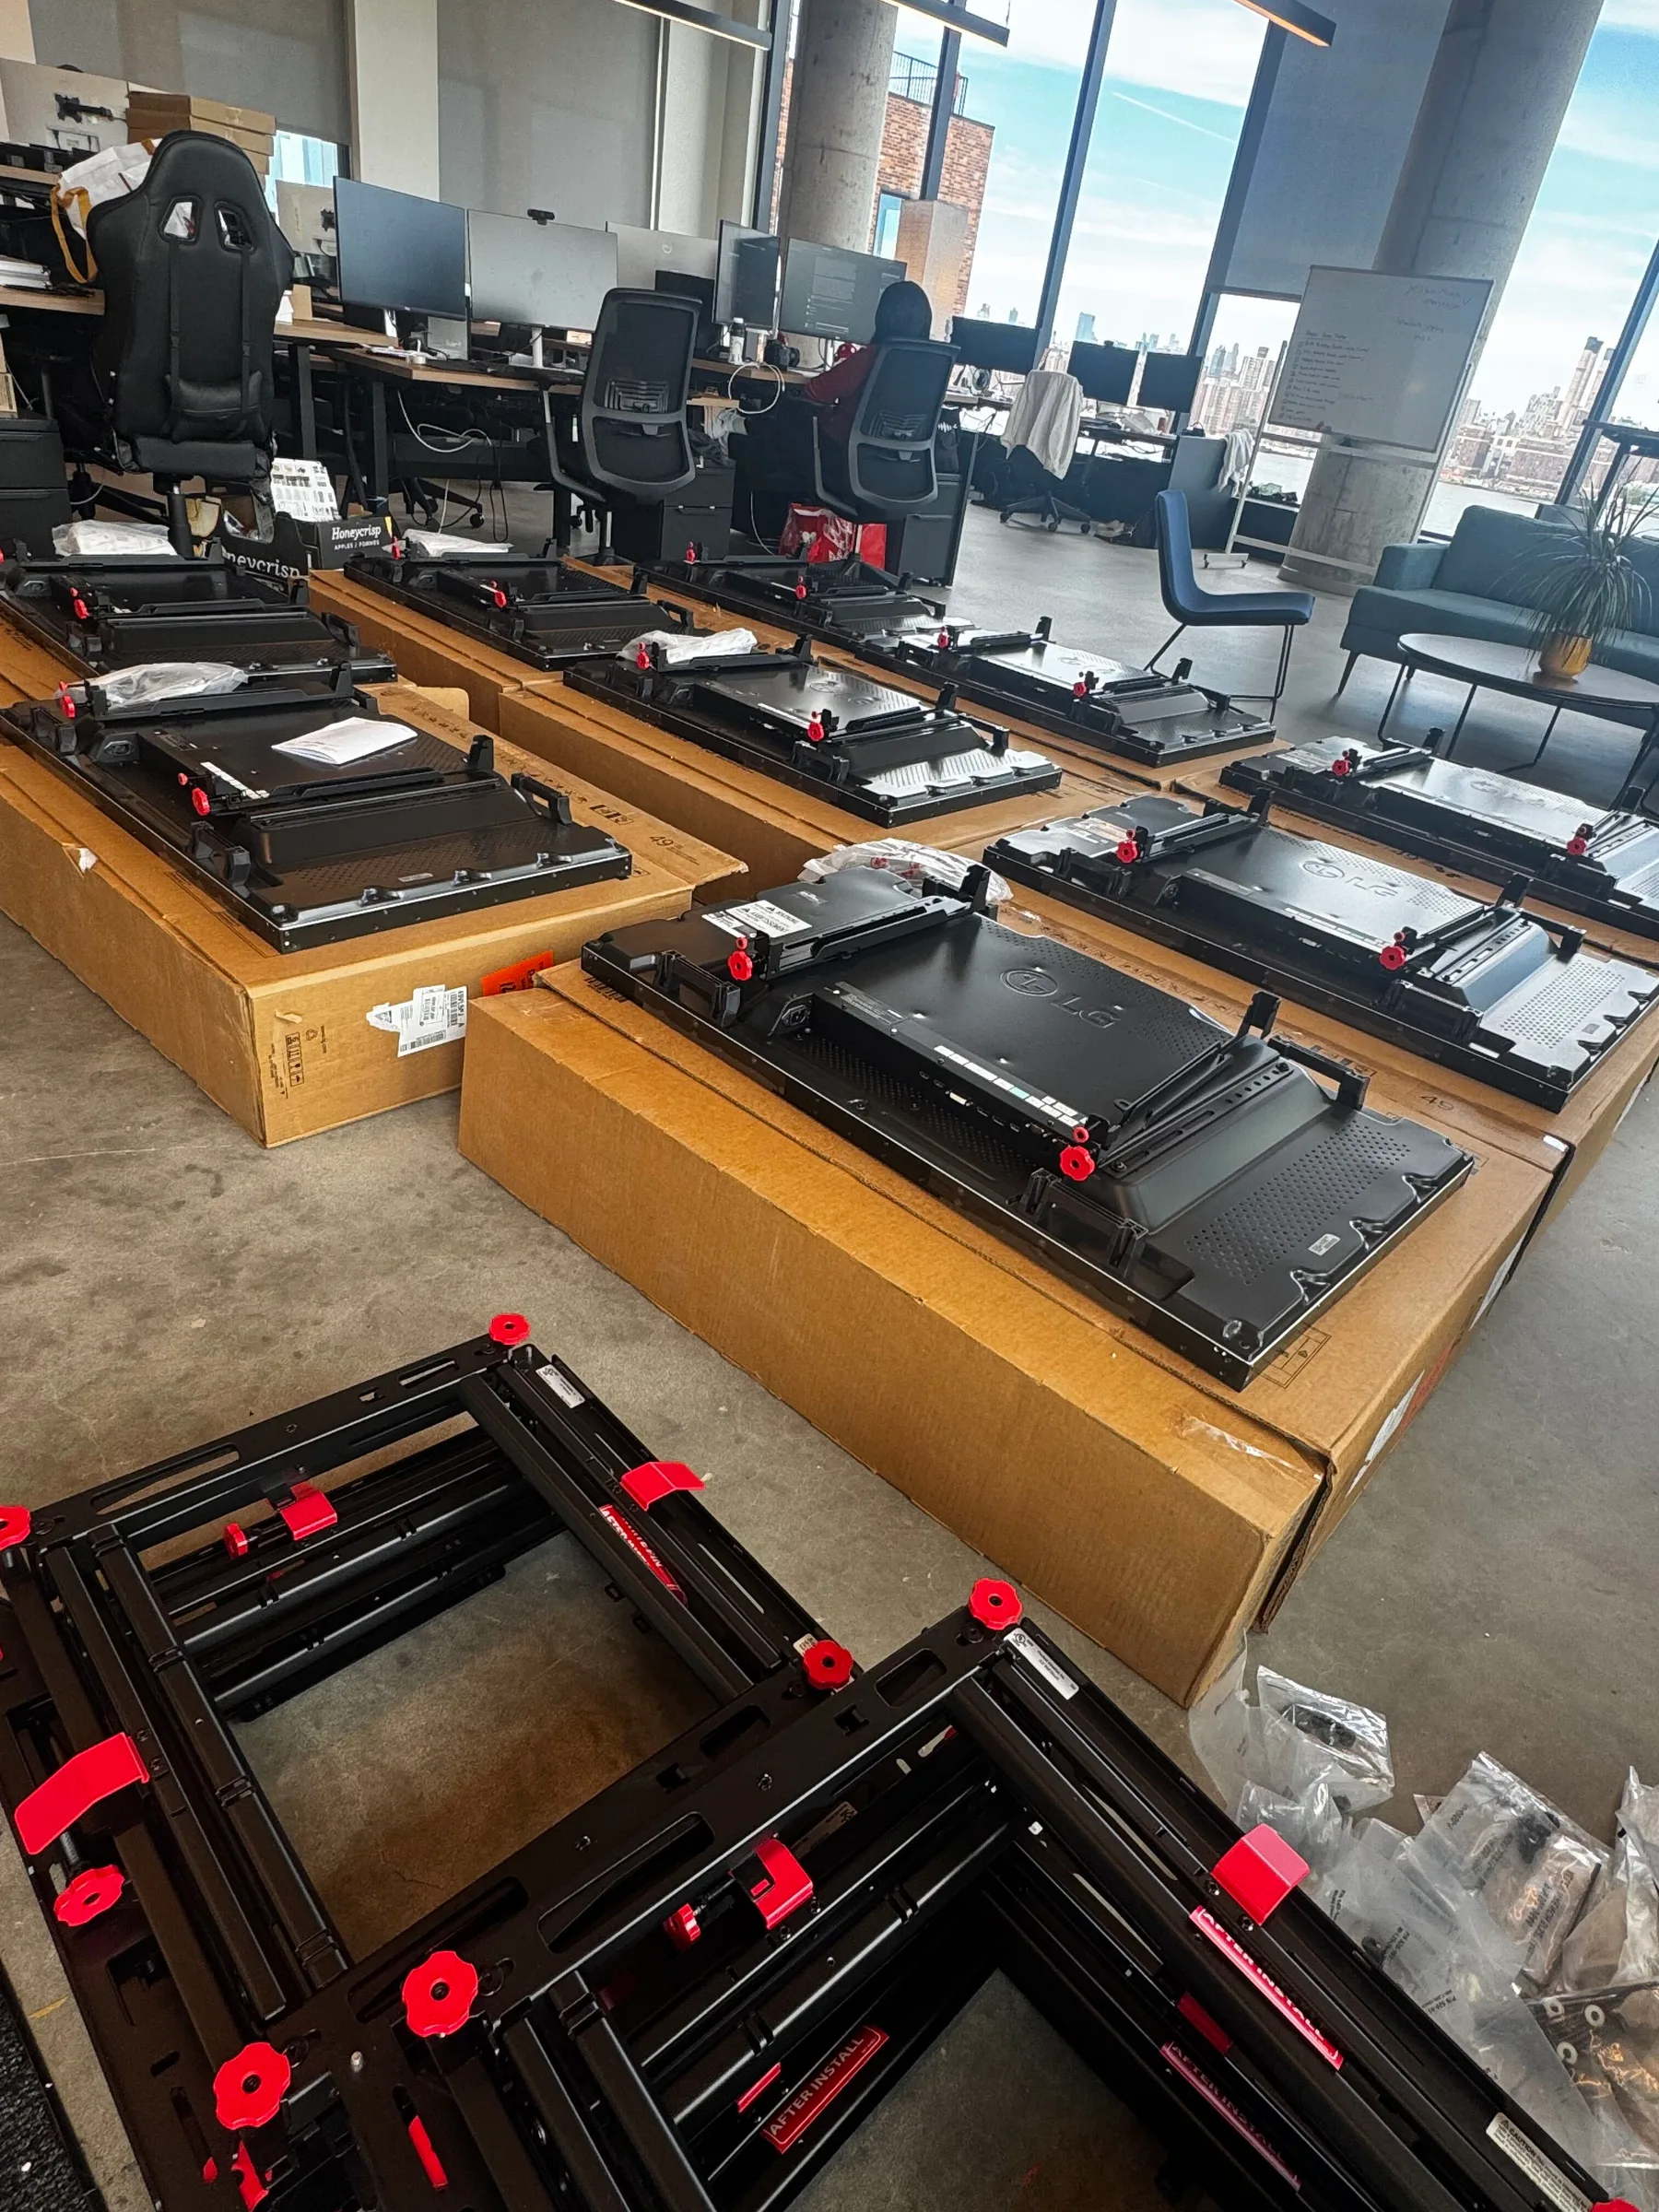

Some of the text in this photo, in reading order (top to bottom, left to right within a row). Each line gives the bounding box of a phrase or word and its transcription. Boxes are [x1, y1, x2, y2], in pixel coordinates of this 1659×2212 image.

[331, 524, 382, 541] Honeycrisp
[1346, 877, 1398, 897] LG
[1052, 993, 1122, 1029] LG
[1202, 1912, 1323, 2041] AFTER INSTALL
[770, 2039, 864, 2136] AFTER INSTALL
[1510, 2127, 1538, 2157] CAUTION
